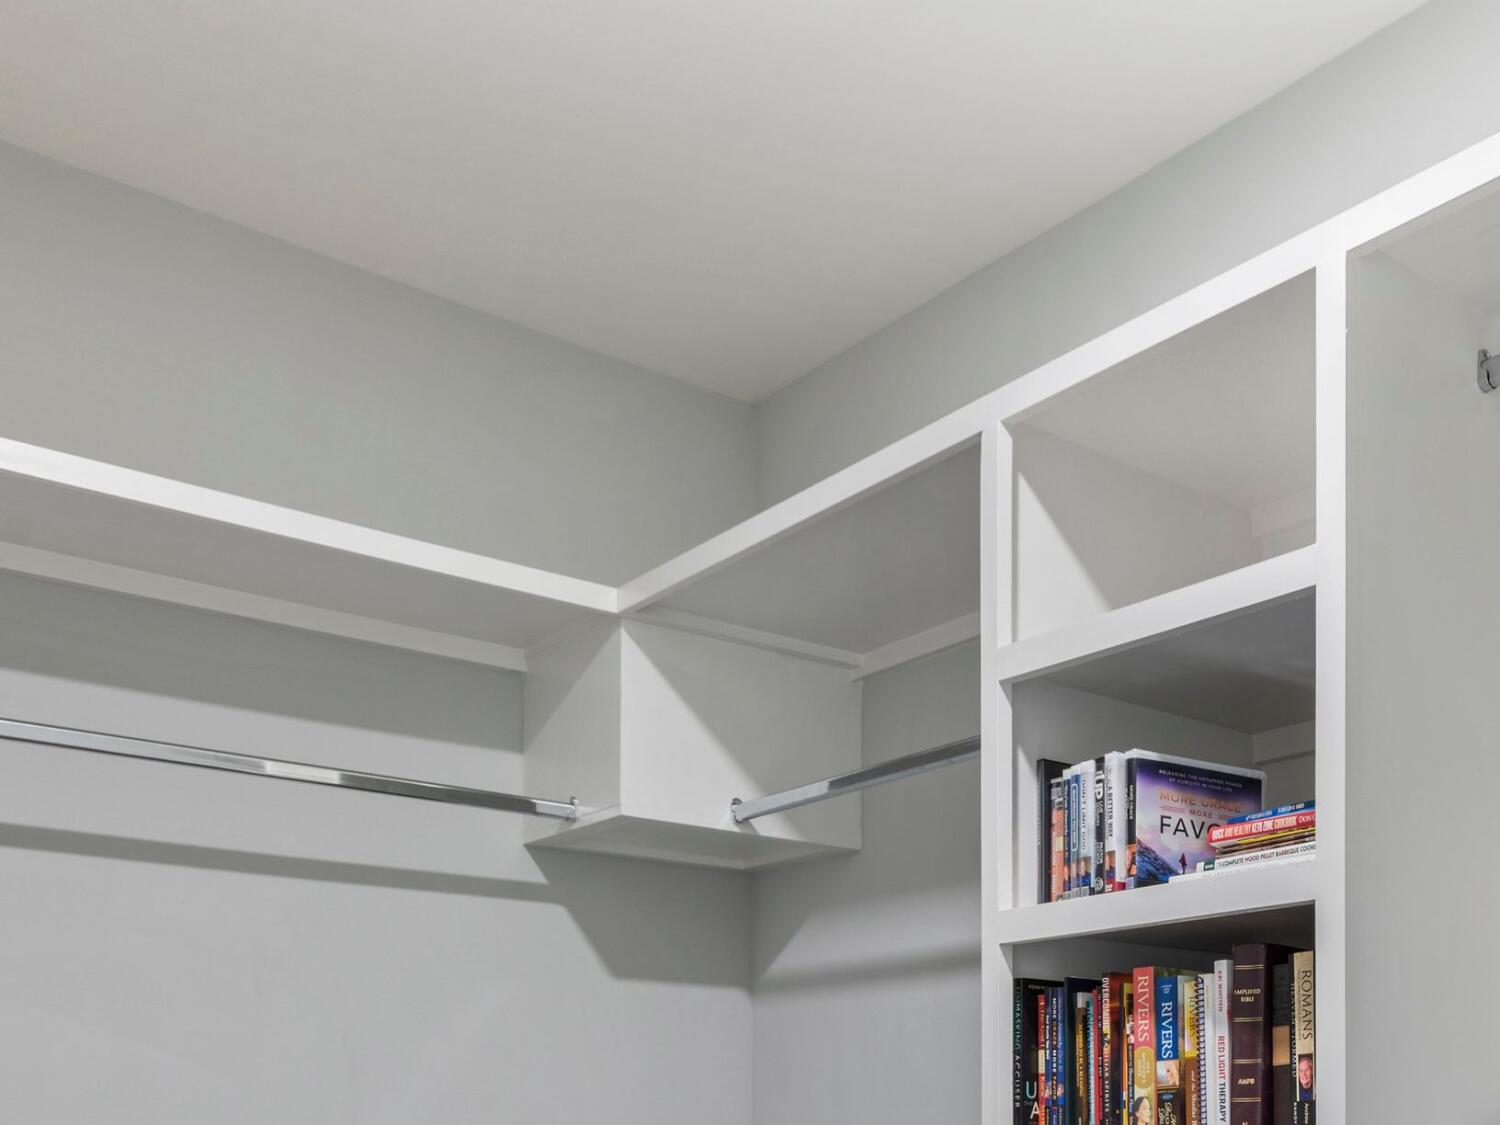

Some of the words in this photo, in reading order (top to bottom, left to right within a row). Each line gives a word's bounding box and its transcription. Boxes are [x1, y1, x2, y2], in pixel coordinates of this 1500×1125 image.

[1159, 792, 1196, 806] MORE
[1200, 798, 1241, 813] GRACE
[1189, 810, 1213, 819] MORE
[1245, 853, 1259, 863] WOOD
[1260, 851, 1275, 860] PELLET
[1276, 847, 1299, 857] BARBEQUE
[1137, 976, 1149, 1042] RIVERS
[1302, 970, 1312, 1040] ROMANS
[1161, 1002, 1173, 1059] RIVERS
[1218, 1082, 1226, 1122] THERAPY
